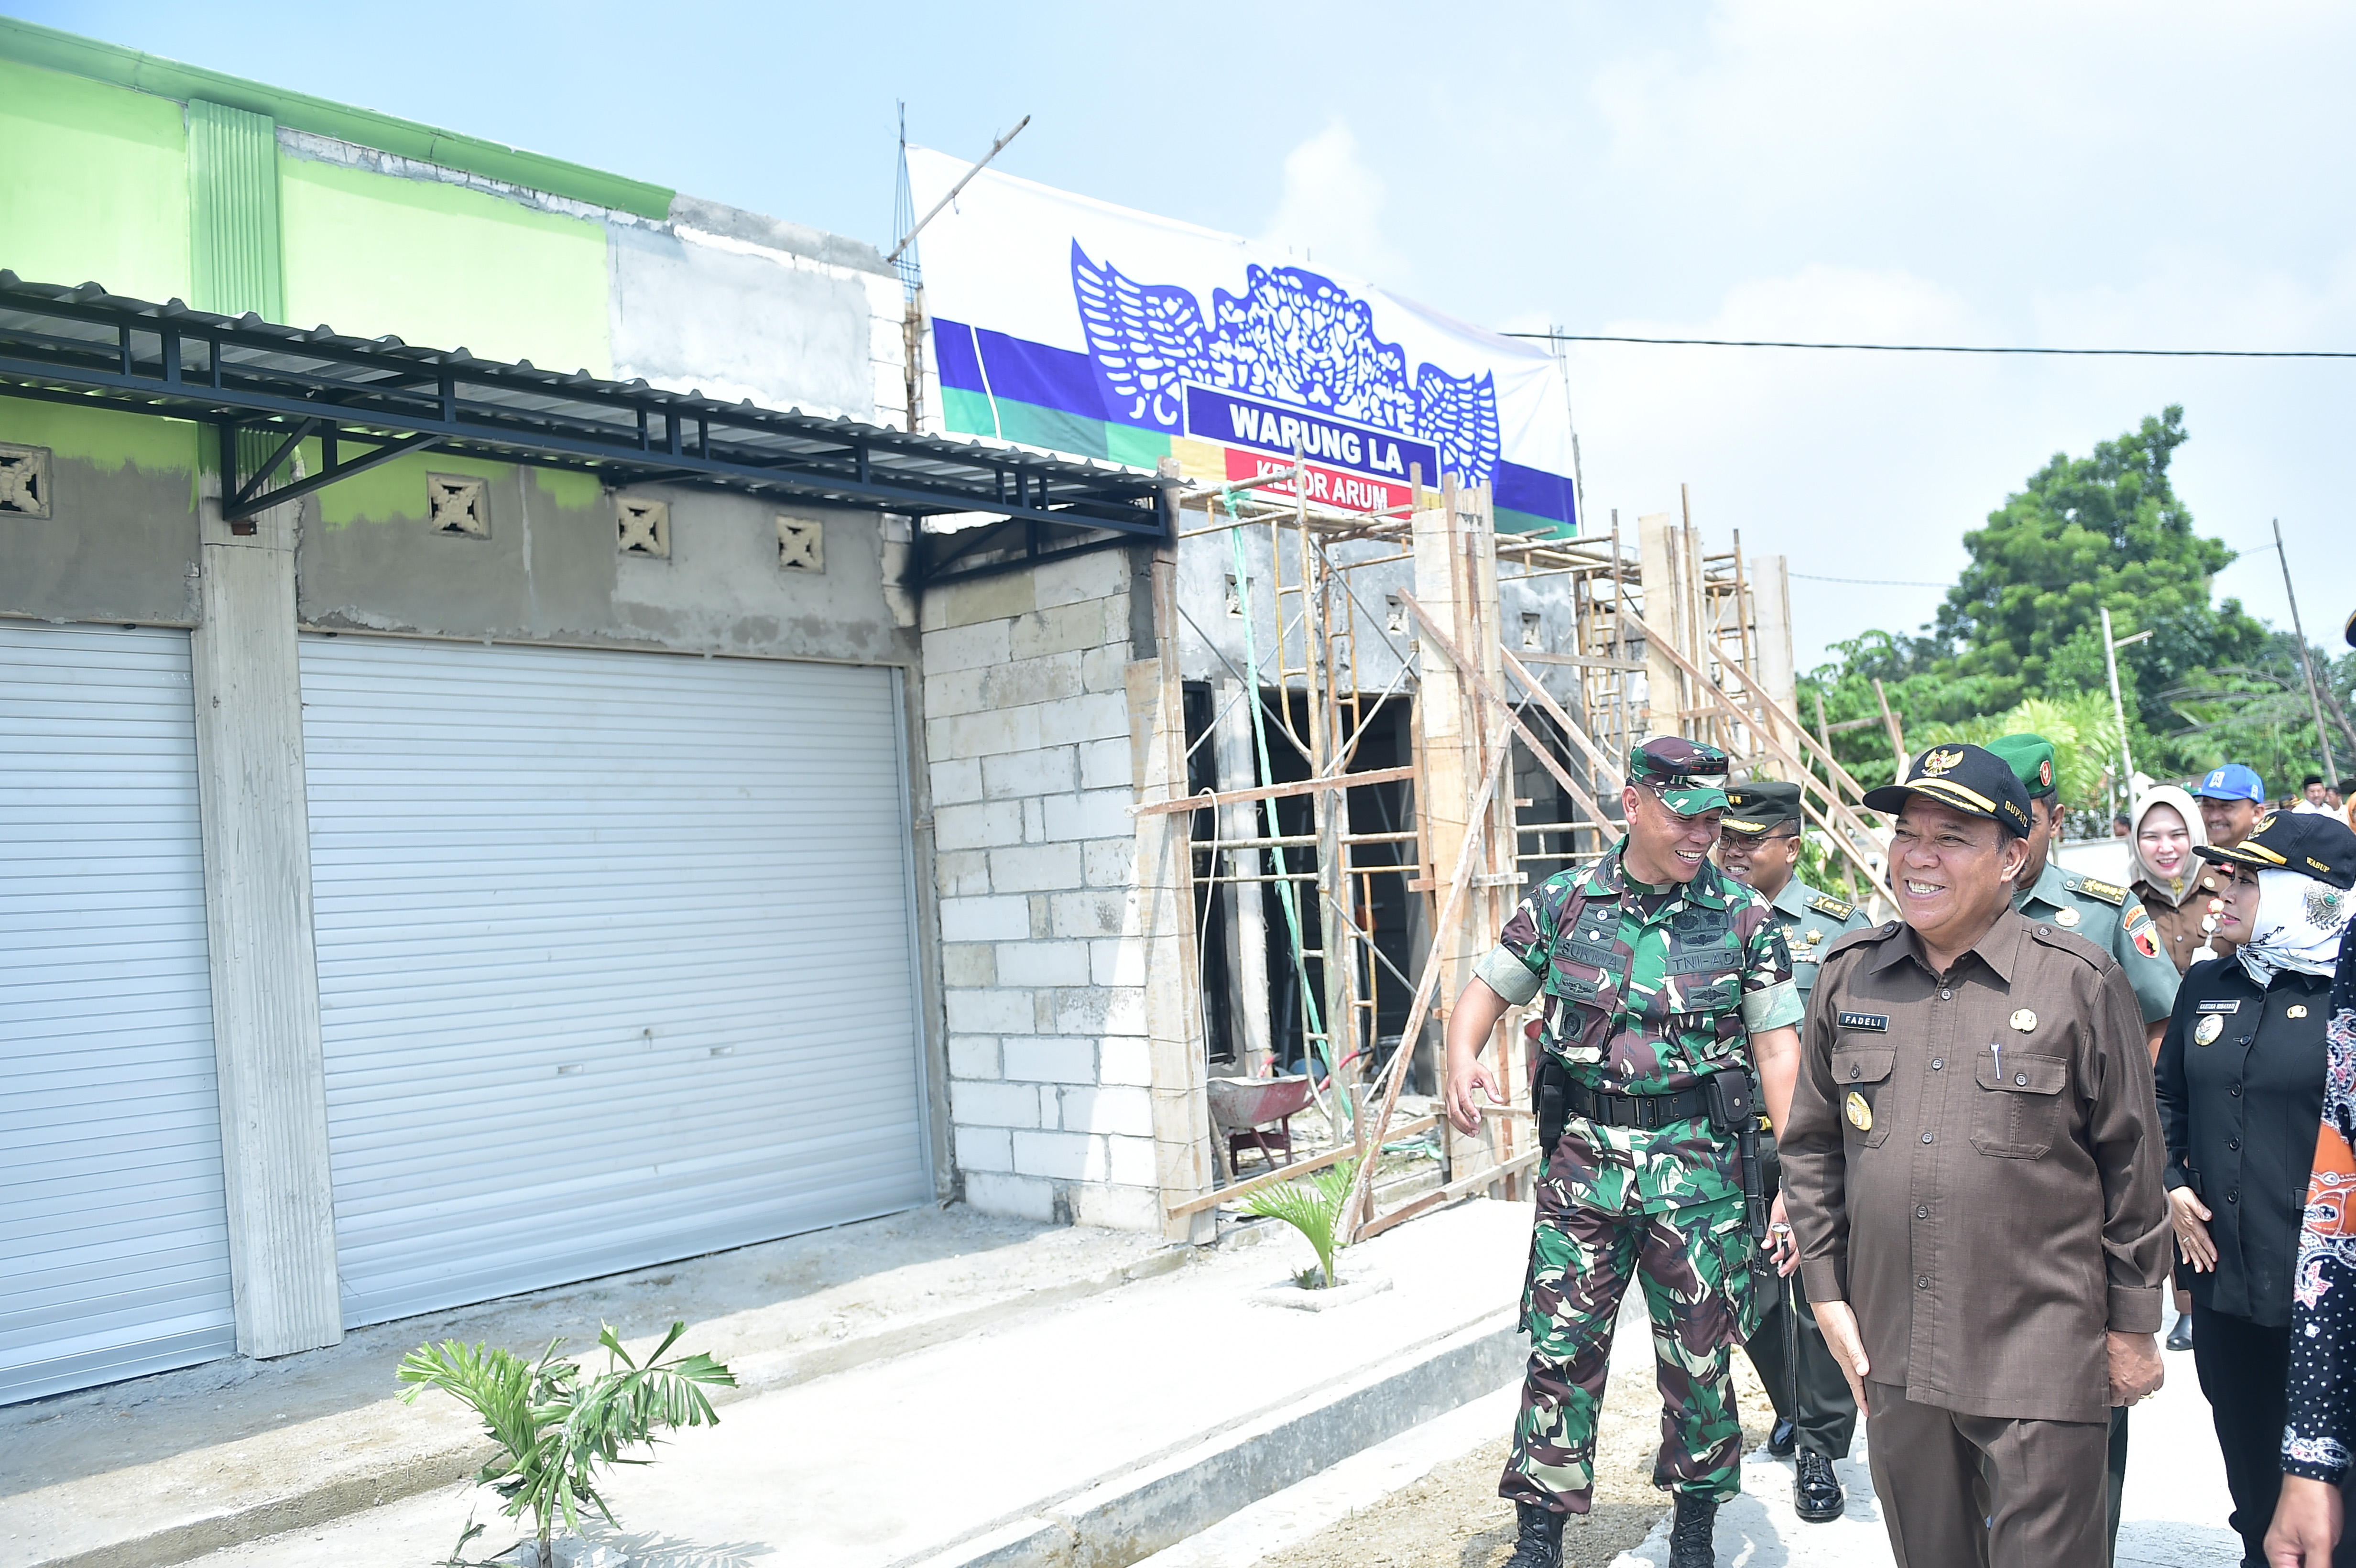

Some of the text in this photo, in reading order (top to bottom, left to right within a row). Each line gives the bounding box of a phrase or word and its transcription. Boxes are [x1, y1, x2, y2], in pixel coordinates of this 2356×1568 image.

[1229, 403, 1405, 475] WARUNG LA
[1332, 477, 1388, 511] ARUM
[2005, 800, 2028, 827] BUPATI
[2307, 857, 2330, 872] WABUP
[1561, 943, 1617, 969] SUKMA
[1673, 952, 1735, 970] TNI-AD
[1845, 1016, 1880, 1026] FADELI
